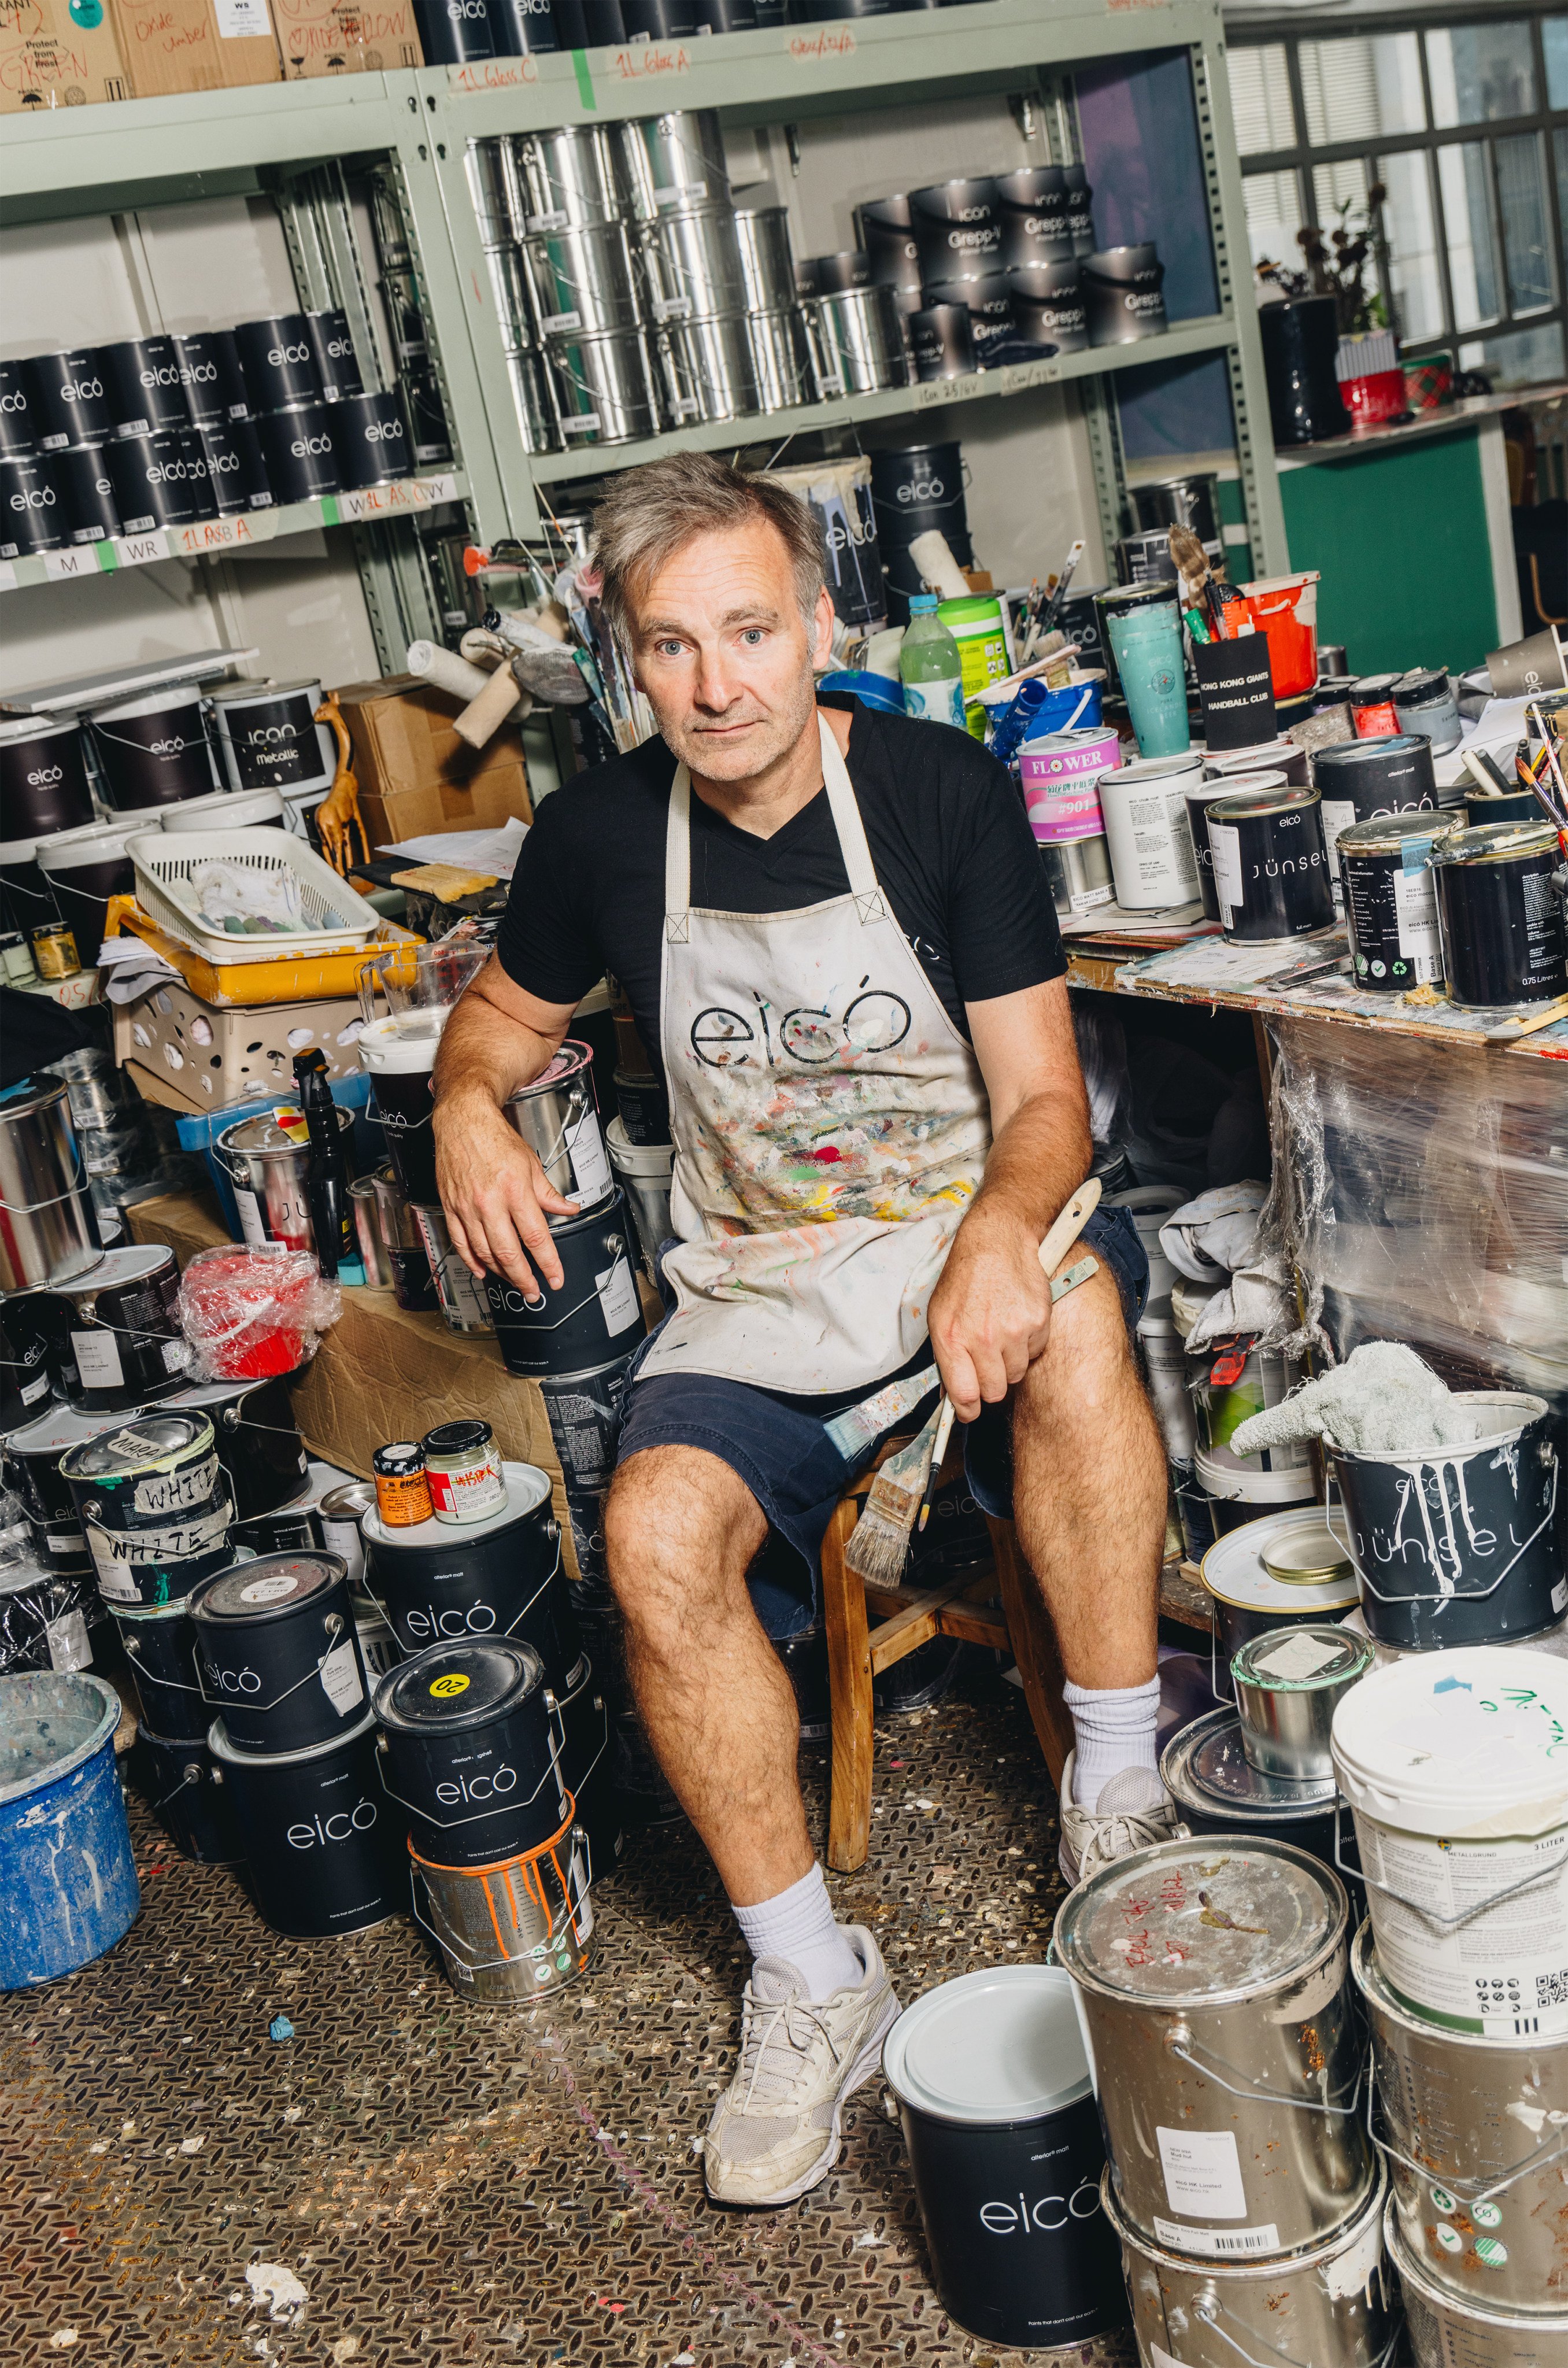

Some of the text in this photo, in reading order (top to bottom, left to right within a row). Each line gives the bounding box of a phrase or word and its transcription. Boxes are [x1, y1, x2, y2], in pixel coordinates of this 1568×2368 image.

[268, 341, 310, 367] eicó
[327, 337, 354, 358] eic
[60, 376, 103, 402] eicó
[365, 418, 404, 443] eicó
[291, 433, 332, 458] eicó
[10, 485, 56, 512] eicó
[897, 476, 944, 503] eicó
[126, 541, 158, 560] WR
[60, 556, 79, 572] M
[1219, 677, 1245, 690] KONG
[1246, 671, 1269, 684] GIANTS
[1208, 692, 1269, 711] HANDBALL CLUB
[27, 764, 63, 786] eicó
[1057, 799, 1089, 815] #901
[1279, 814, 1301, 828] eicó
[1537, 974, 1554, 982] Litres
[691, 974, 912, 1069] eicó
[145, 1466, 216, 1510] WHITE
[106, 1527, 210, 1561] WHITE
[406, 1599, 496, 1637] eicó
[205, 1664, 261, 1693] eicó
[435, 1679, 465, 1694] 20
[338, 1773, 349, 1782] matt
[436, 1763, 517, 1805] eicó
[287, 1797, 377, 1849] eicó
[1541, 1836, 1566, 1850] LITER
[1056, 2145, 1070, 2155] matt
[979, 2175, 1101, 2234] eicó
[1160, 2230, 1175, 2241] Base
